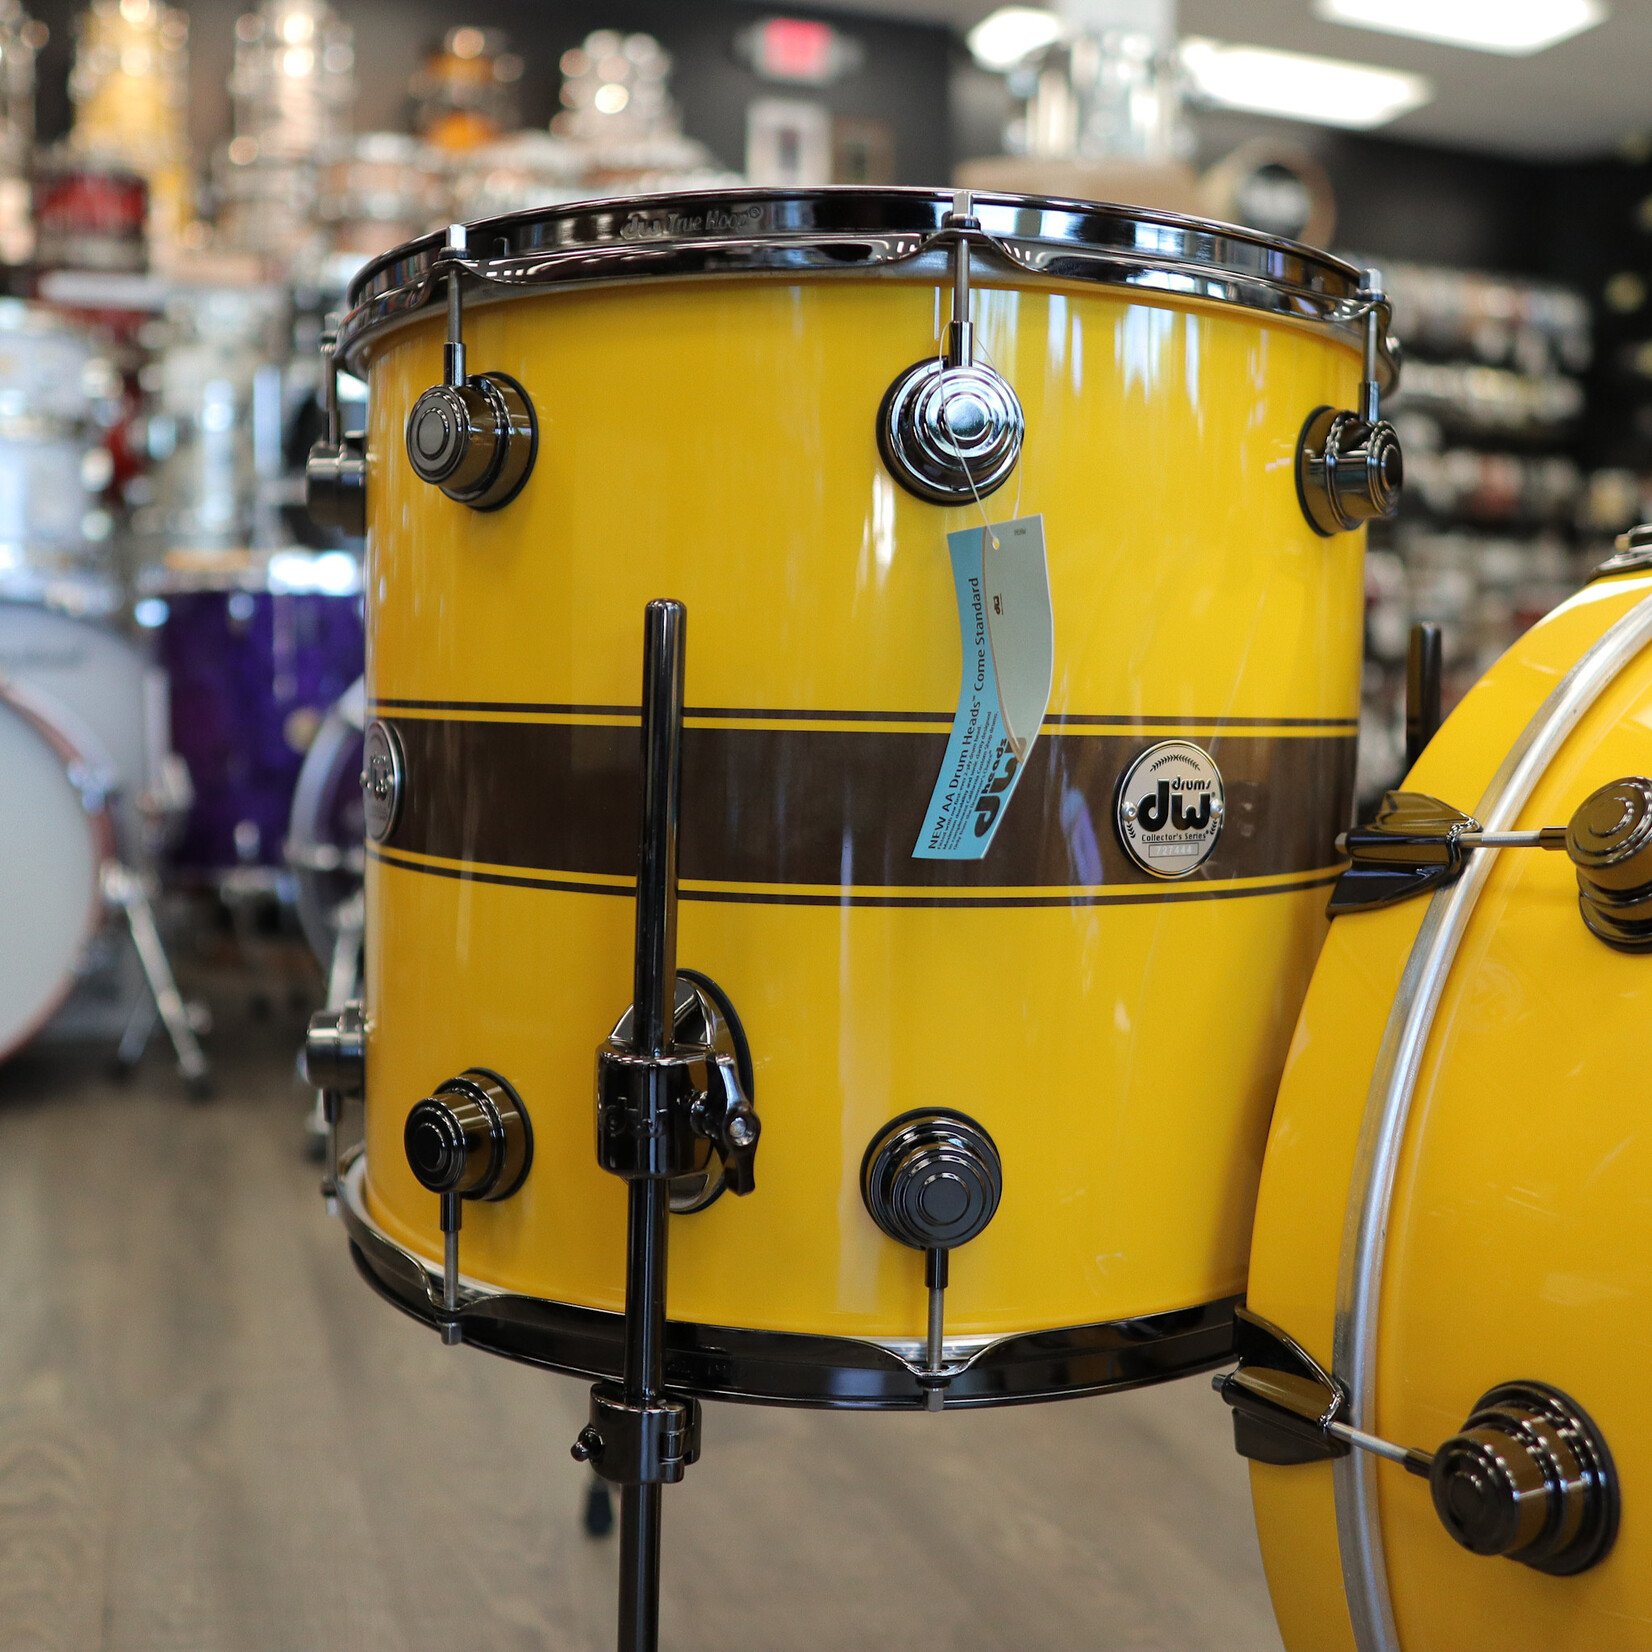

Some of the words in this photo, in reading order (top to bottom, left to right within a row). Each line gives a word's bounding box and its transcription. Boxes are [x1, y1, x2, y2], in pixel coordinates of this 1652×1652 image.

[668, 213, 702, 232] True
[969, 577, 984, 644] Standard
[974, 649, 985, 690] Come
[949, 750, 968, 787] Drum
[982, 738, 1006, 793] heads
[1171, 775, 1212, 791] drums
[942, 792, 954, 811] AA
[1136, 778, 1212, 832] dw
[929, 816, 945, 848] NEW
[1141, 833, 1182, 842] Collector's
[1185, 832, 1207, 841] Series
